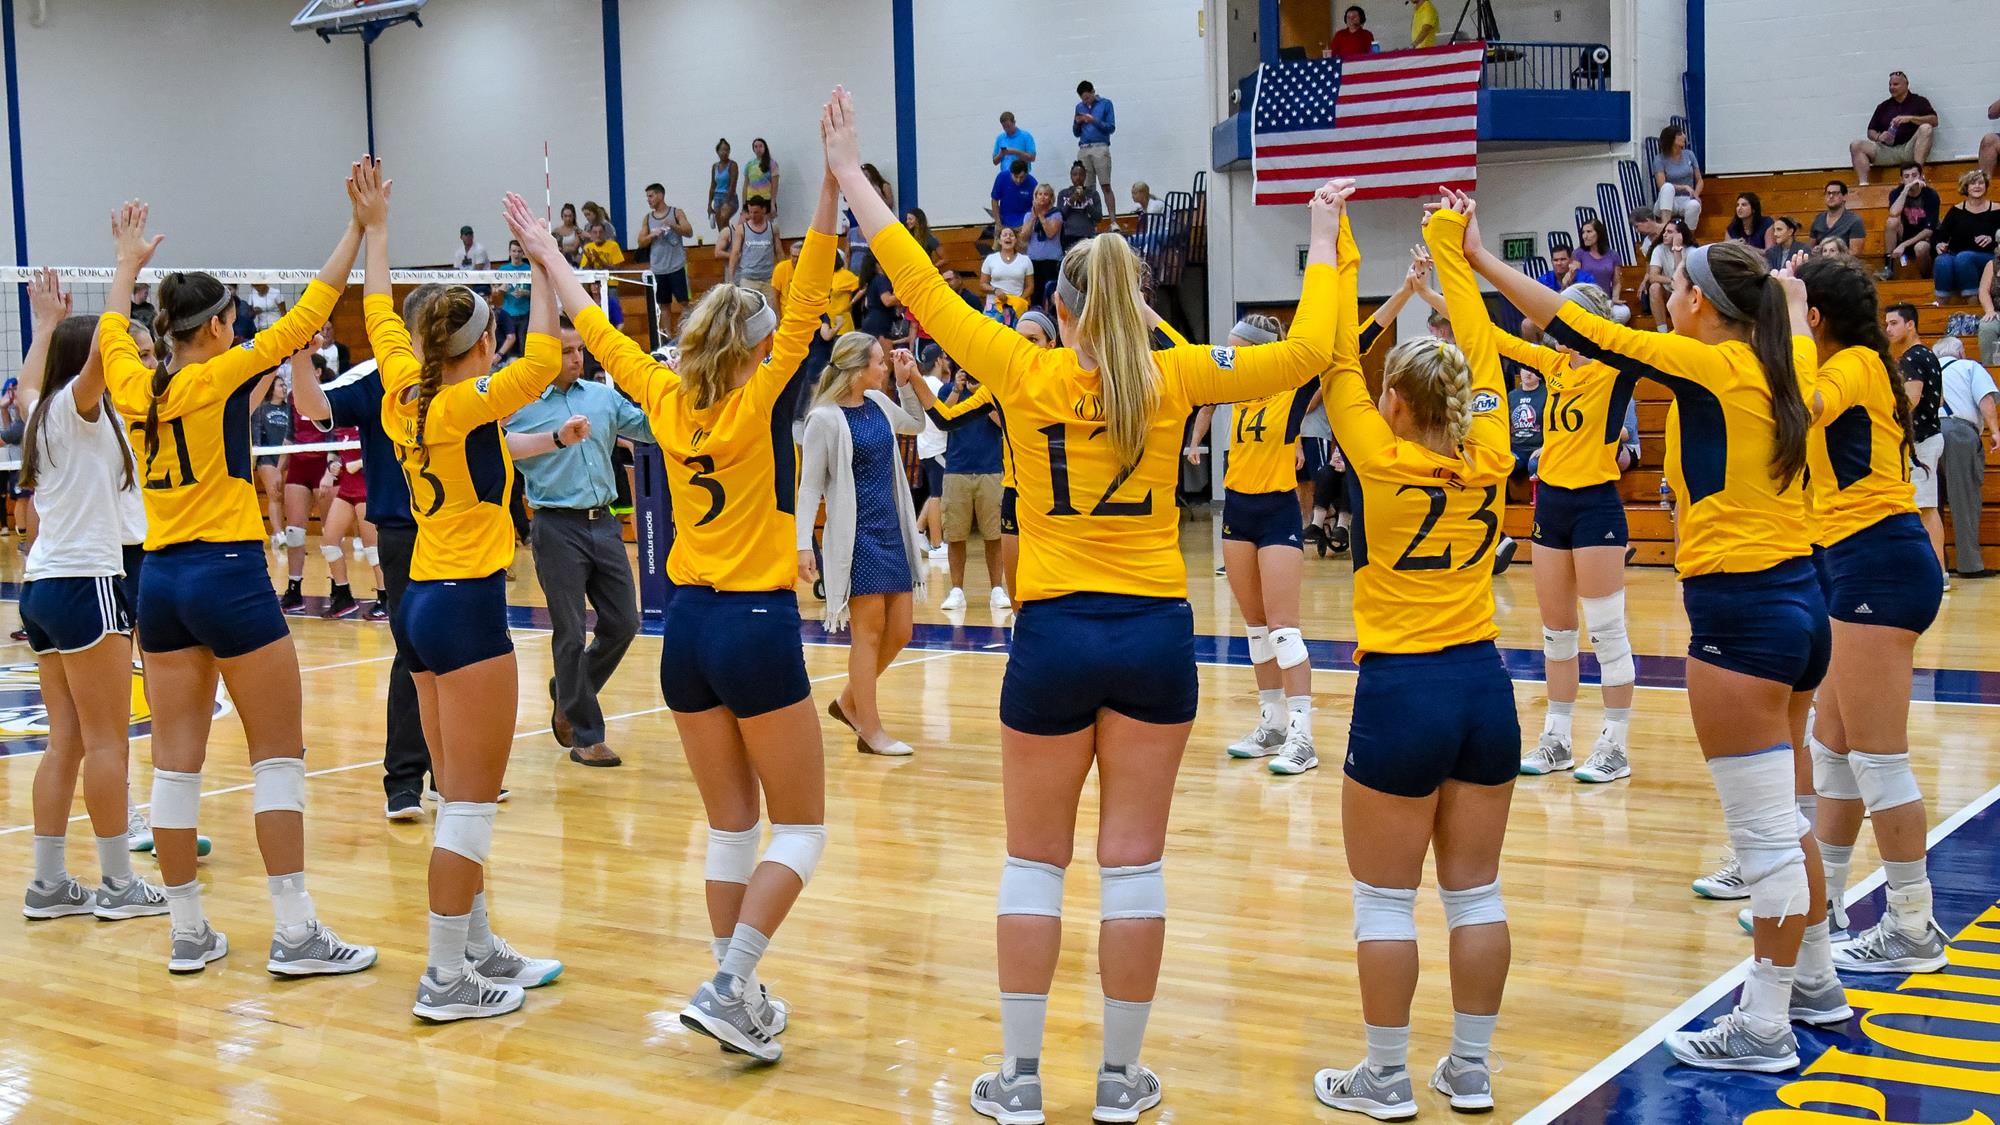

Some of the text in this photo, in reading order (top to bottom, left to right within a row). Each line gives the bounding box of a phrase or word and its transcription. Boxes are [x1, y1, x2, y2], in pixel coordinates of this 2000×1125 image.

[1507, 241, 1529, 256] EXIT
[1236, 406, 1267, 444] 14
[1548, 392, 1584, 432] 16
[130, 416, 200, 489] 21
[1037, 422, 1153, 516] 12
[684, 454, 726, 527] 3
[1392, 484, 1499, 570] 23
